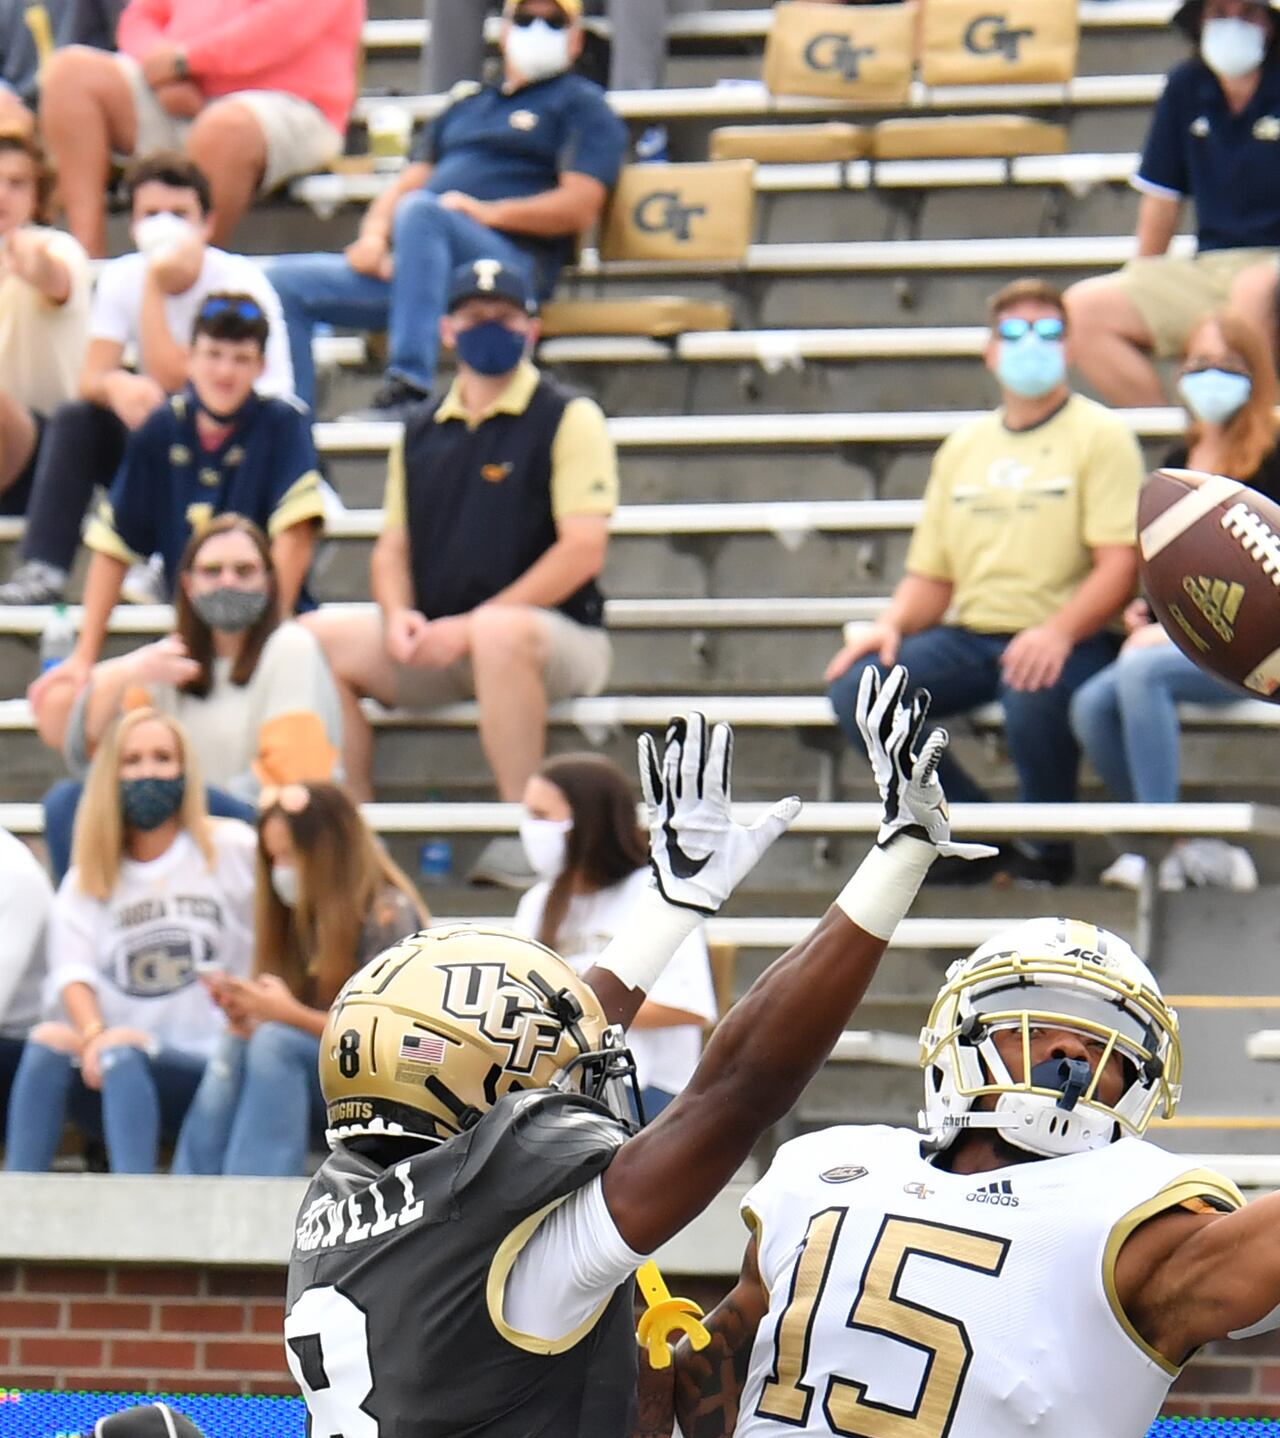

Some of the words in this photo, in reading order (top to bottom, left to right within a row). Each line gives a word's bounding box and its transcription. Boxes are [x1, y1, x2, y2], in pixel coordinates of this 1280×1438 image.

[634, 191, 707, 240] GT
[1064, 948, 1104, 965] ACC
[434, 962, 563, 1076] UCF
[340, 1028, 361, 1079] 8
[966, 1190, 1020, 1208] adidas
